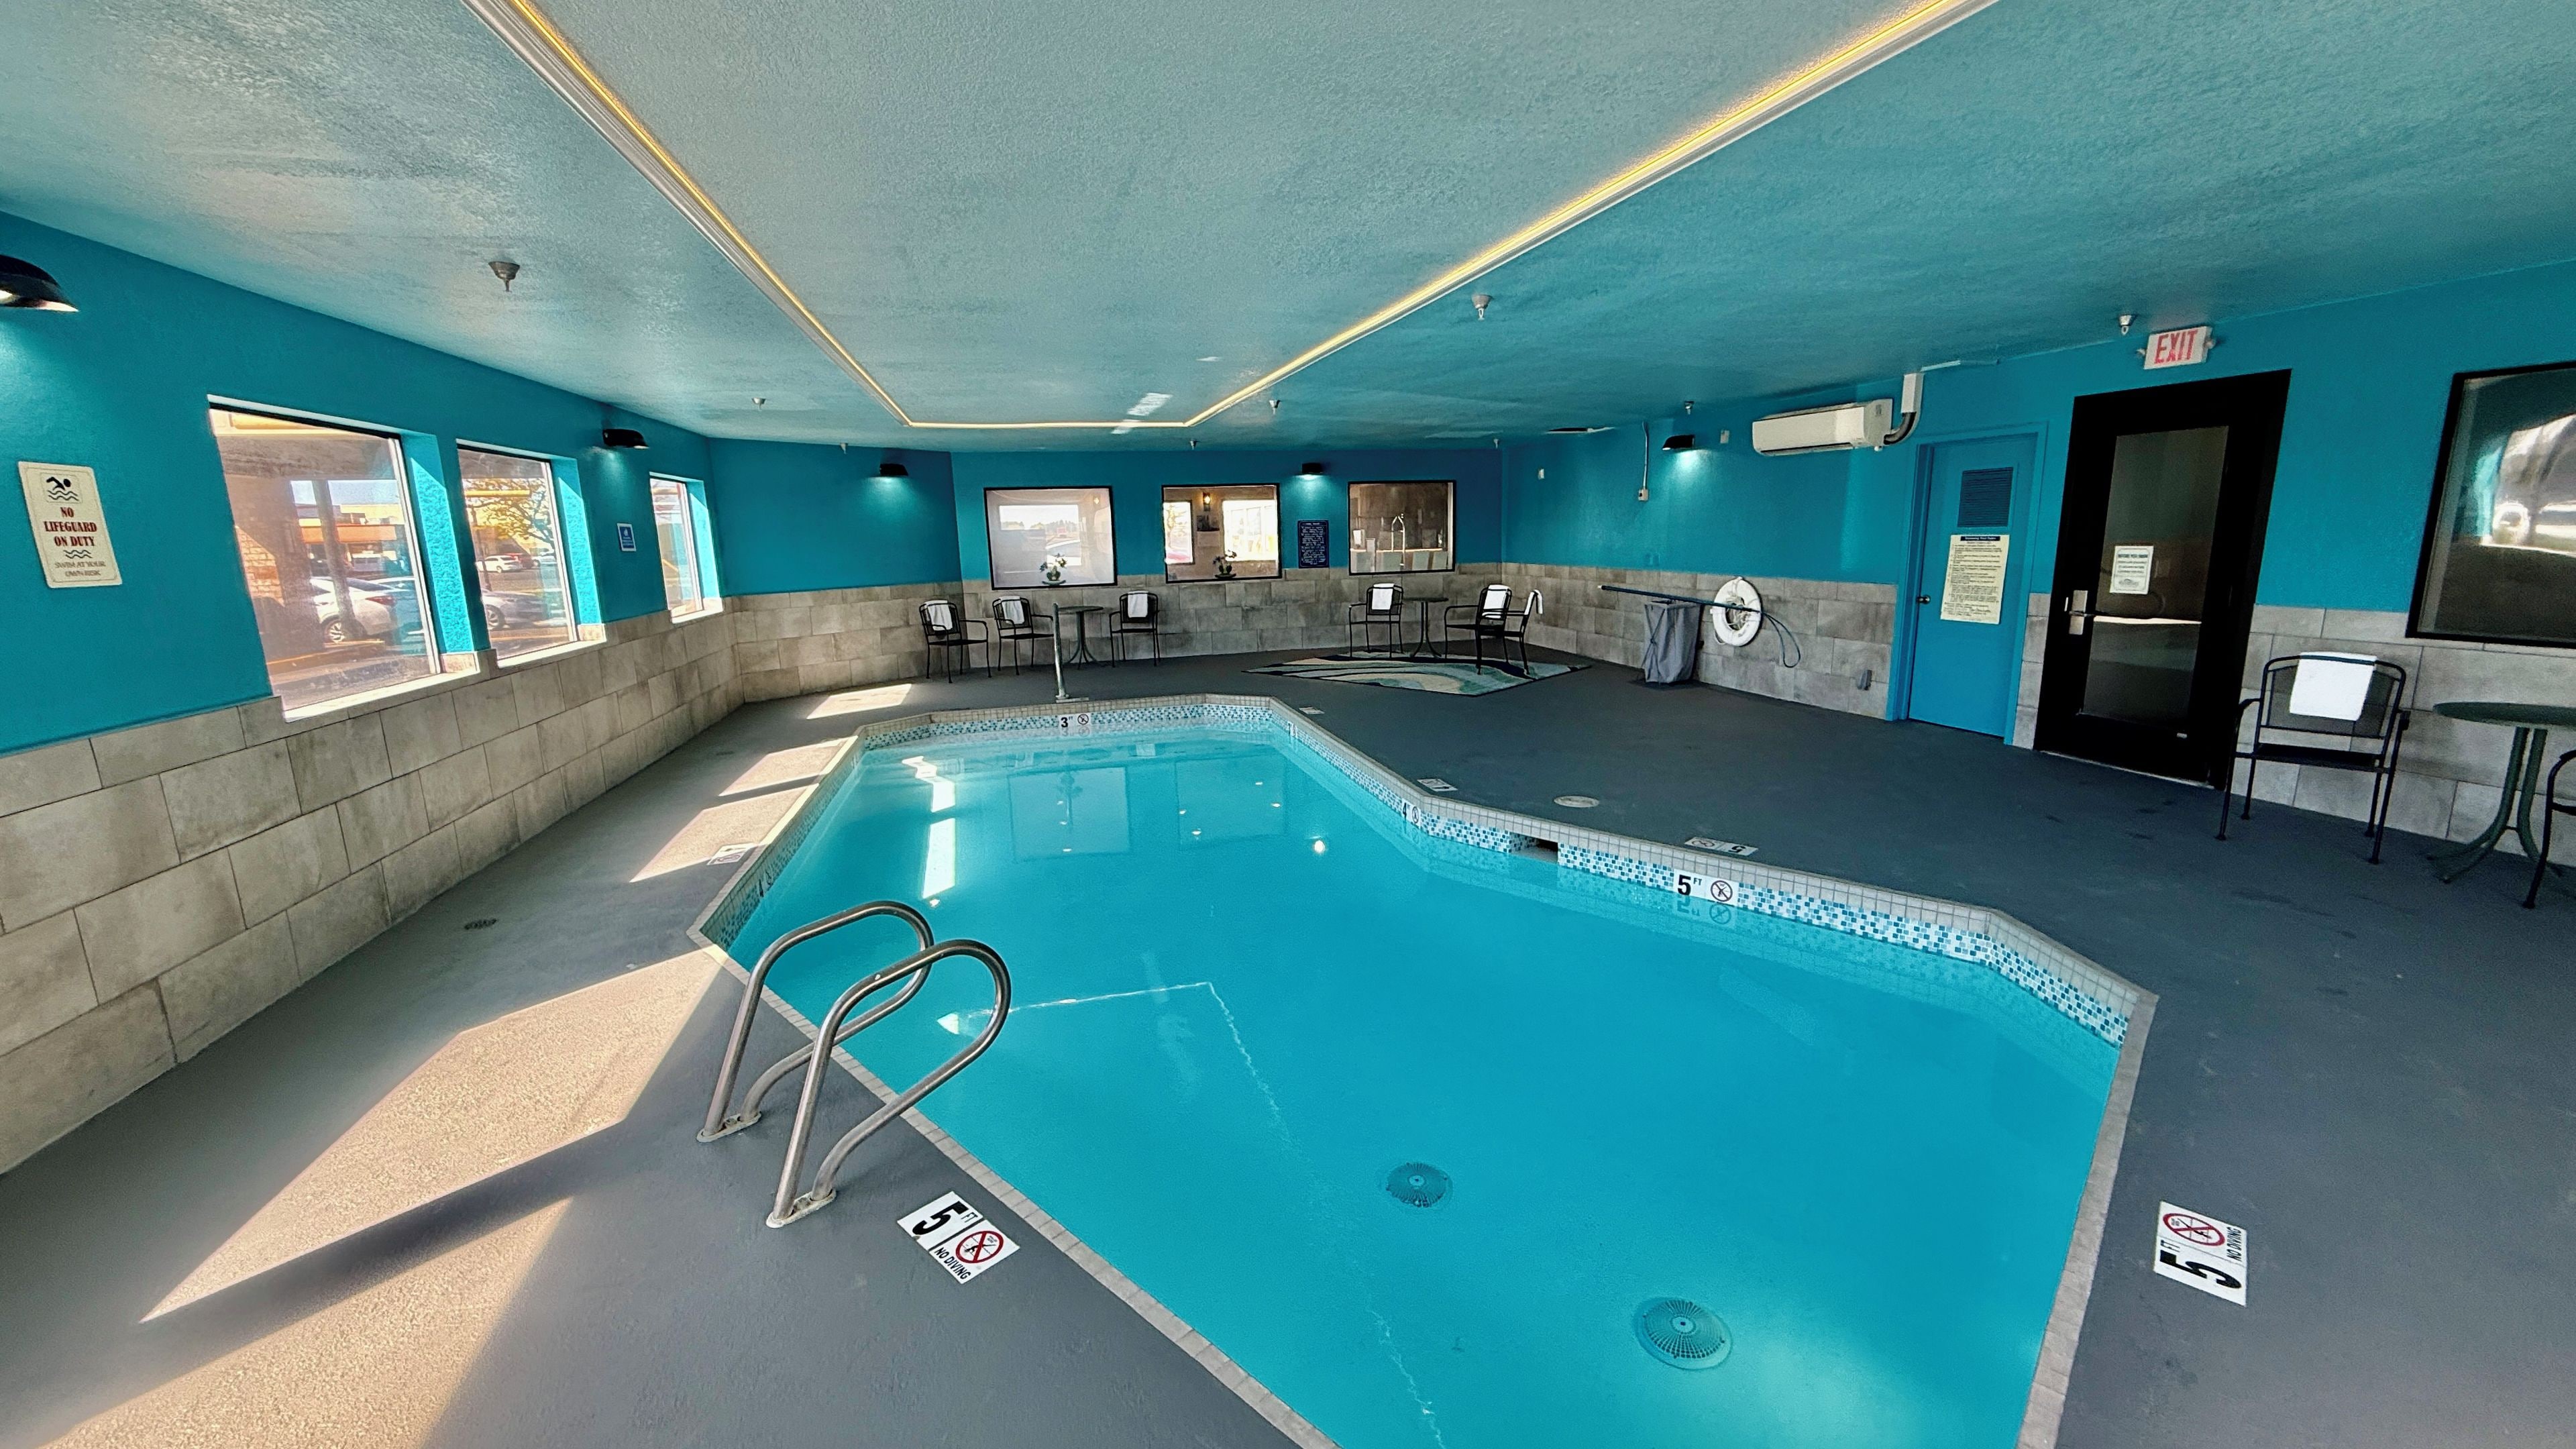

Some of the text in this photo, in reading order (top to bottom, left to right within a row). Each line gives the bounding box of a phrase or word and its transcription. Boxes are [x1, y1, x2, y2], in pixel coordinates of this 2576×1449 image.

[2154, 329, 2198, 364] EXIT
[44, 521, 97, 532] LIFEGUARD
[60, 507, 74, 517] NO
[54, 536, 95, 547] ON DUTY
[1678, 874, 1703, 896] 5 FT
[912, 1201, 978, 1235] 5 FT
[2226, 1227, 2243, 1262] NO DIVING
[934, 1247, 971, 1280] NO DIVING
[2159, 1240, 2242, 1289] 5 FT
